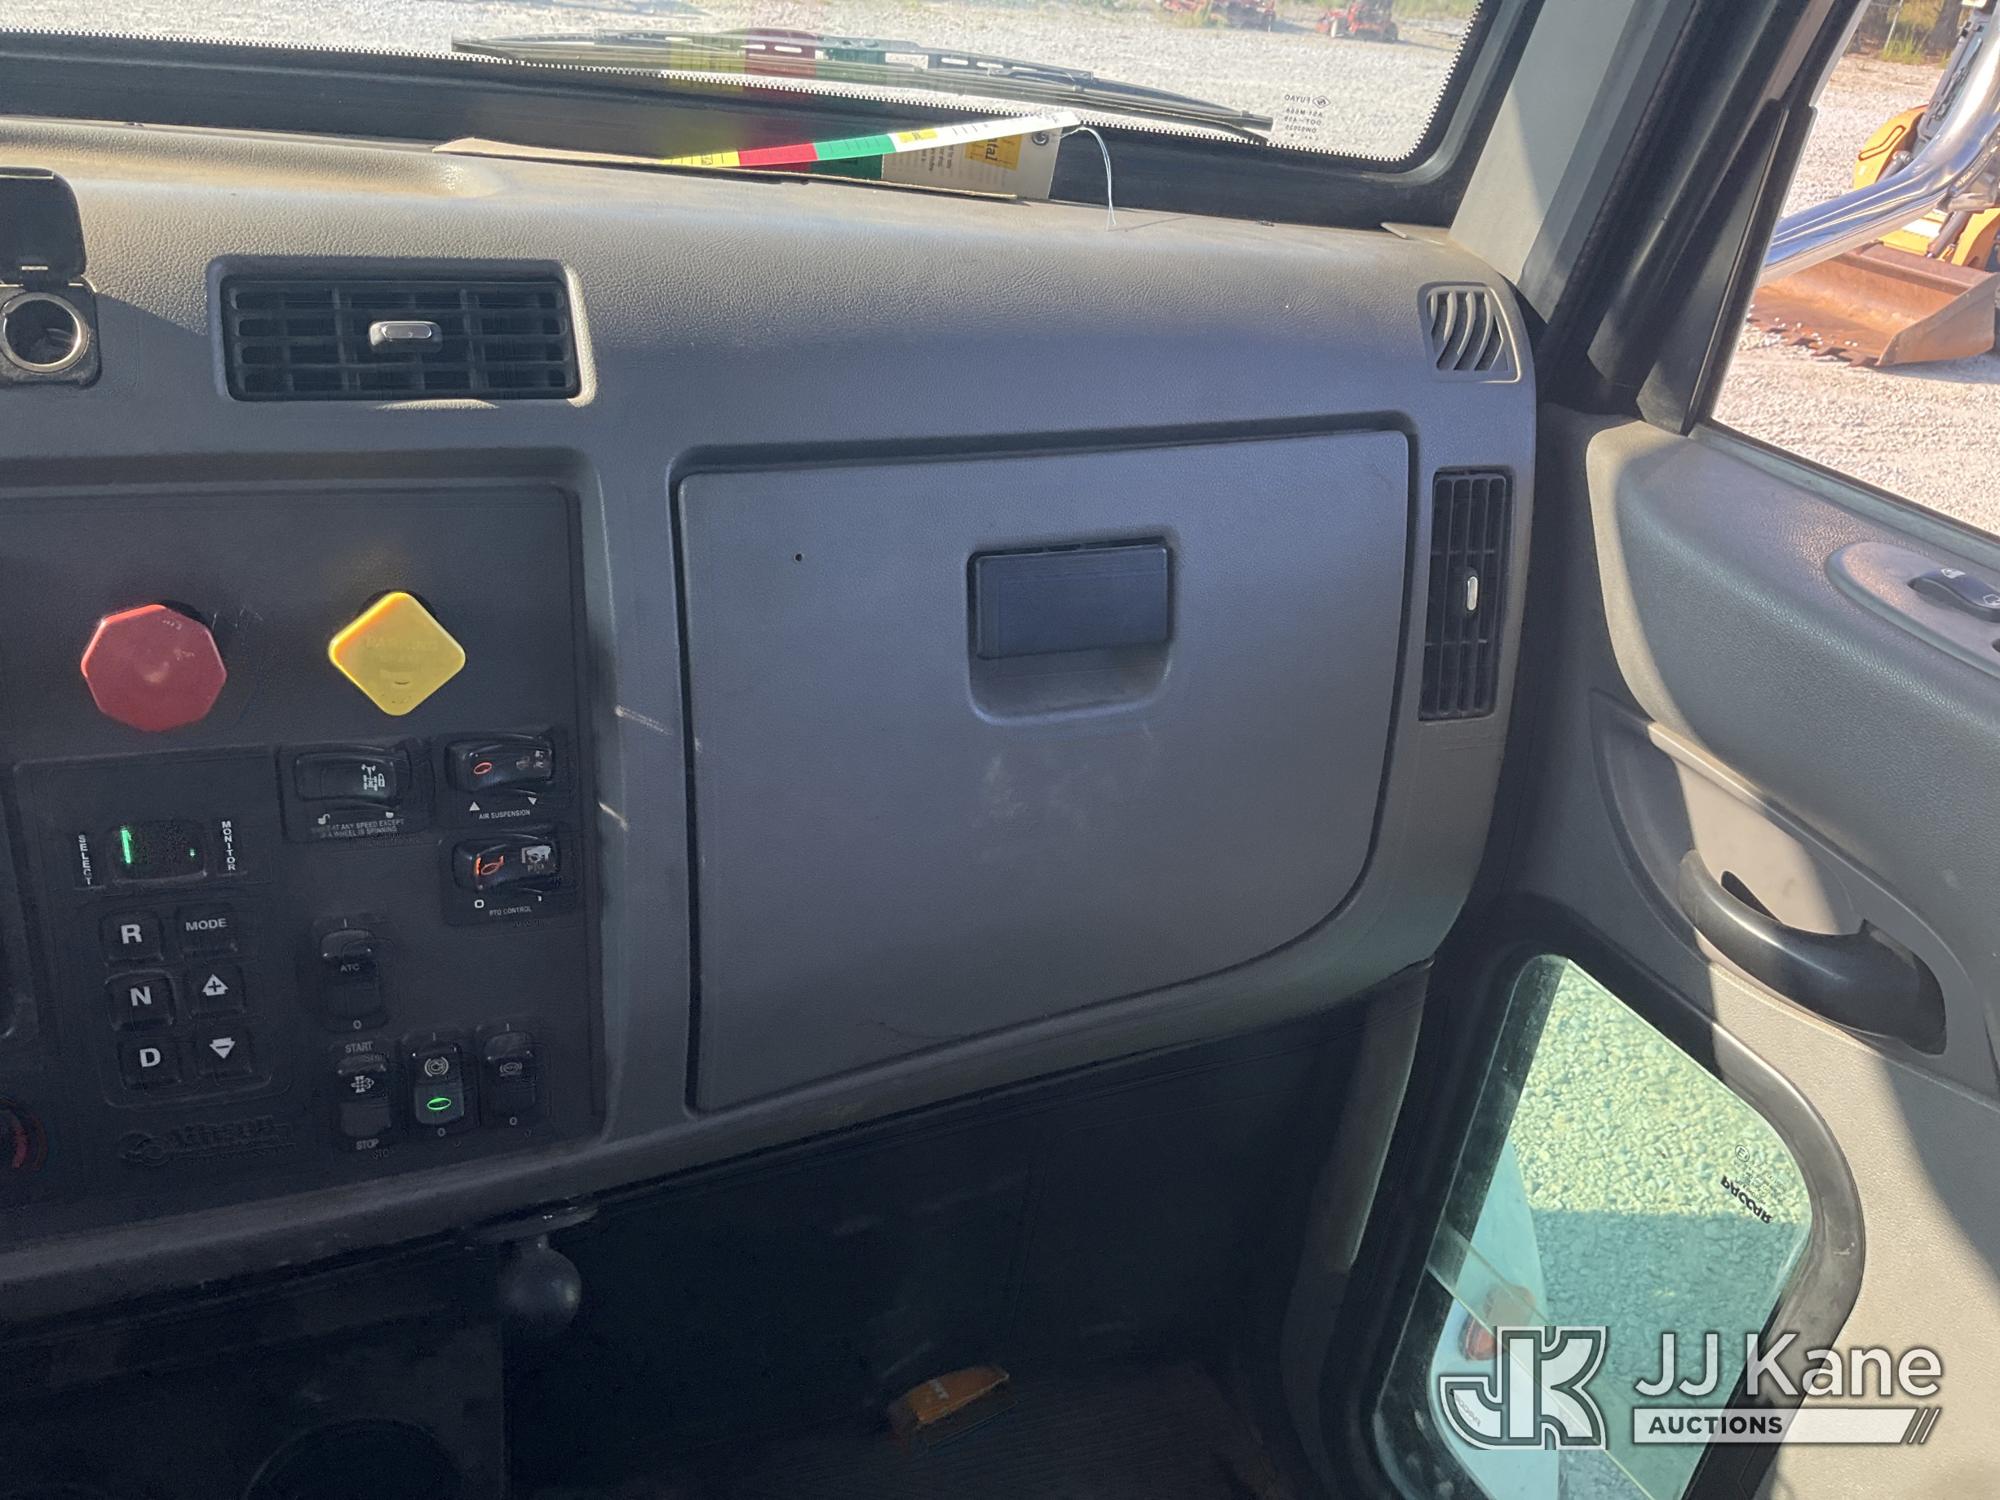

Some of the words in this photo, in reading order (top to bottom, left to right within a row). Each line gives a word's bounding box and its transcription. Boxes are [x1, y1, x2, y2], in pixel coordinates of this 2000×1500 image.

[478, 812, 490, 820] AIR
[491, 809, 531, 819] SUSPENSION
[221, 820, 236, 871] MONITOR
[78, 834, 91, 886] SELECT
[503, 905, 532, 915] CONTROL
[185, 918, 228, 932] MODE
[120, 923, 143, 944] R
[340, 963, 360, 973] ATC
[130, 985, 152, 1007] N
[344, 1041, 374, 1054] START
[139, 1047, 161, 1067] D
[356, 1138, 380, 1150] STOP
